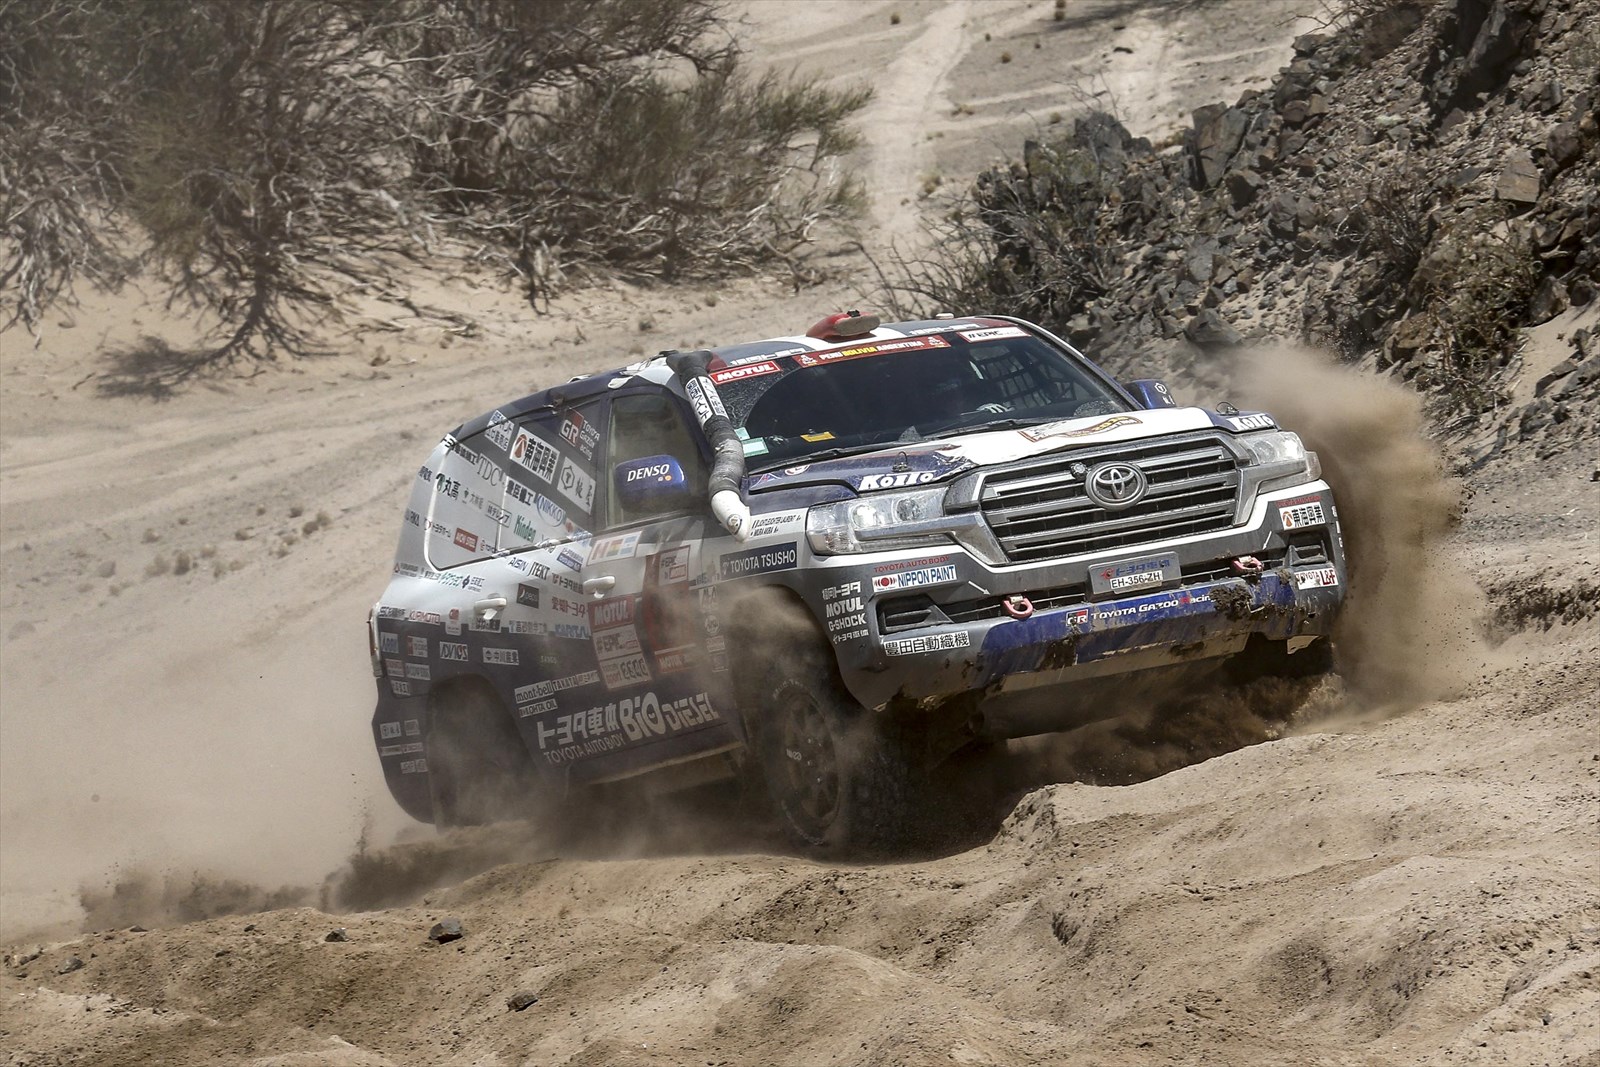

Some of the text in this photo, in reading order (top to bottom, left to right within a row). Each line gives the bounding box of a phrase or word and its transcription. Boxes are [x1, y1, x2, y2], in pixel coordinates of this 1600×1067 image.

[819, 351, 842, 360] PERU
[842, 346, 877, 357] BOLIVIA
[877, 340, 924, 352] ARGENTINA
[717, 364, 775, 381] MOTUL
[561, 420, 579, 443] GR
[627, 464, 670, 482] DENSO
[540, 497, 562, 522] NIKKO
[514, 514, 537, 543] Kinden
[528, 561, 550, 580] JTEKT
[731, 549, 796, 573] TOYOTA TSUSHO
[874, 555, 949, 573] TOYOTA AUTO BODY
[898, 566, 955, 587] NIPPON PAINT
[1111, 572, 1160, 588] EH-356-ZH
[594, 600, 629, 625] MOTUL
[826, 597, 864, 618] MOTUL
[1091, 607, 1137, 619] TOYOTA
[1138, 600, 1179, 612] GAZOO
[828, 613, 867, 631] G-SHOCK
[885, 631, 969, 655] 豊田自動織機
[516, 682, 553, 702] mont-bell
[537, 703, 620, 749] トヨタ車体
[544, 733, 626, 765] TOYOTA AUTO BODY
